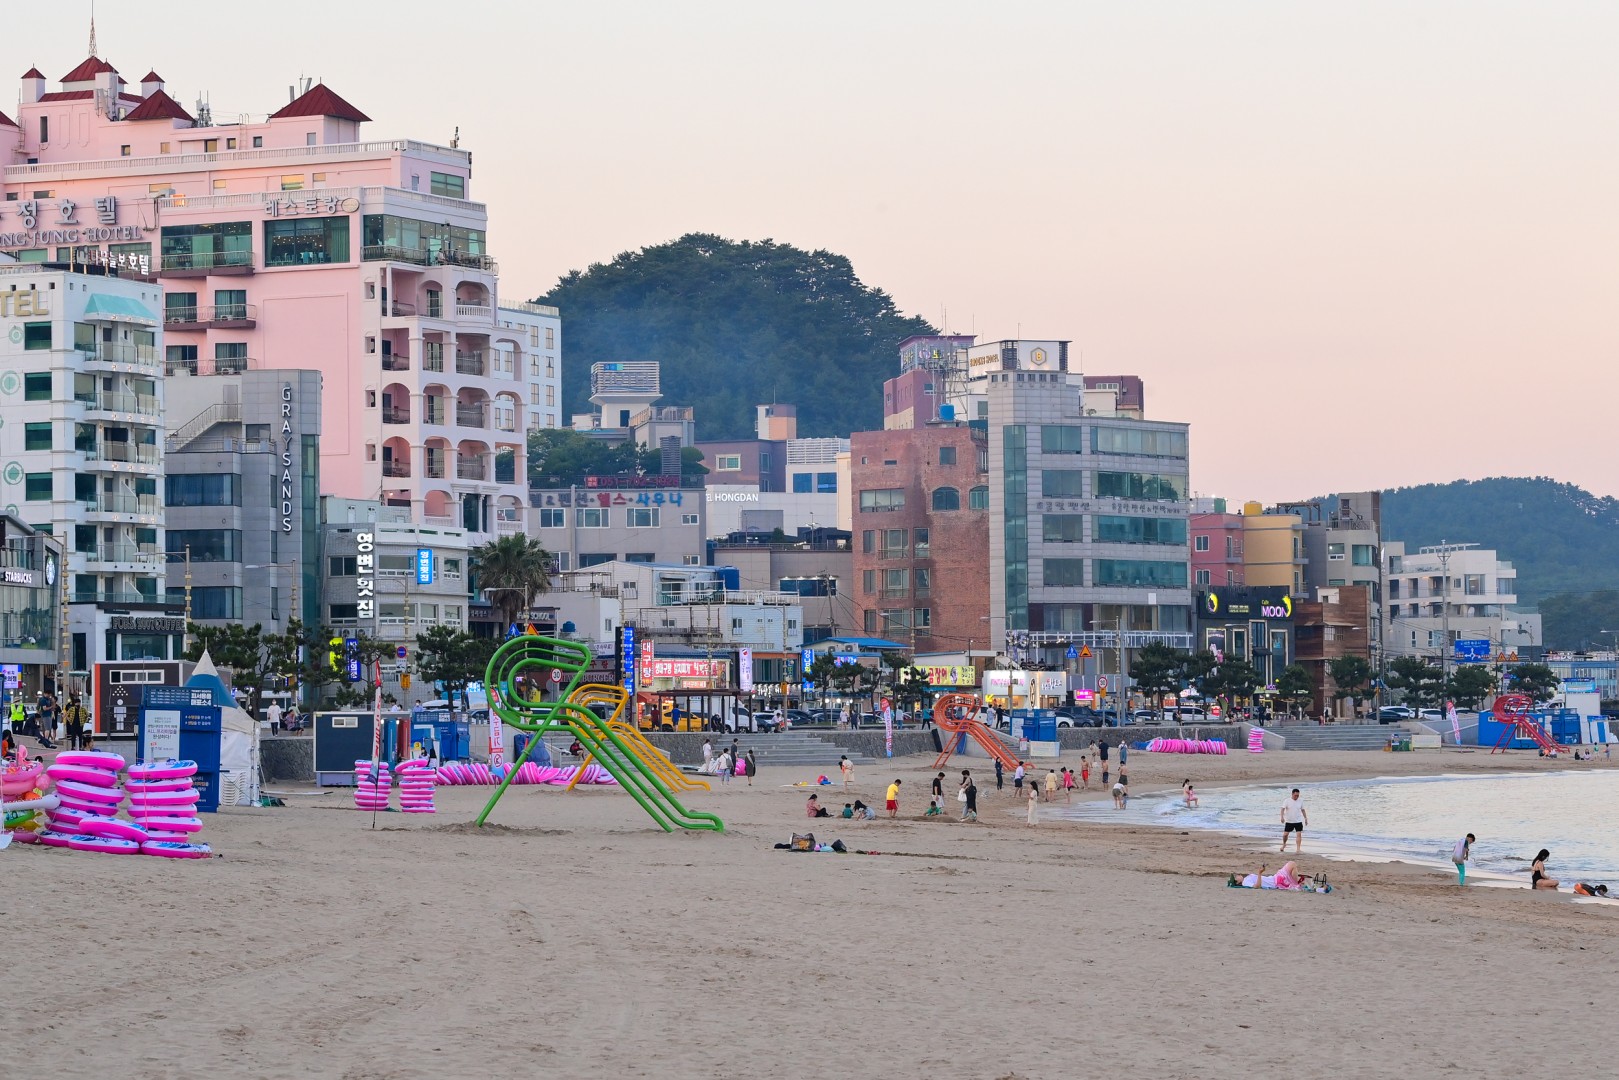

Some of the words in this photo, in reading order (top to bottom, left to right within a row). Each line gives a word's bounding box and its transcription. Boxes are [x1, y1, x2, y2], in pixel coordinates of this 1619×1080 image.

[264, 196, 339, 217] 레스토랑
[85, 225, 143, 242] HOTEL
[714, 493, 759, 502] HONGDAN
[5, 571, 31, 584] STARBUCKS
[356, 532, 374, 619] 영변횟집
[1261, 606, 1288, 617] MOON
[642, 641, 652, 678] 대구탕
[553, 671, 560, 680] 30
[583, 673, 614, 682] BURGER
